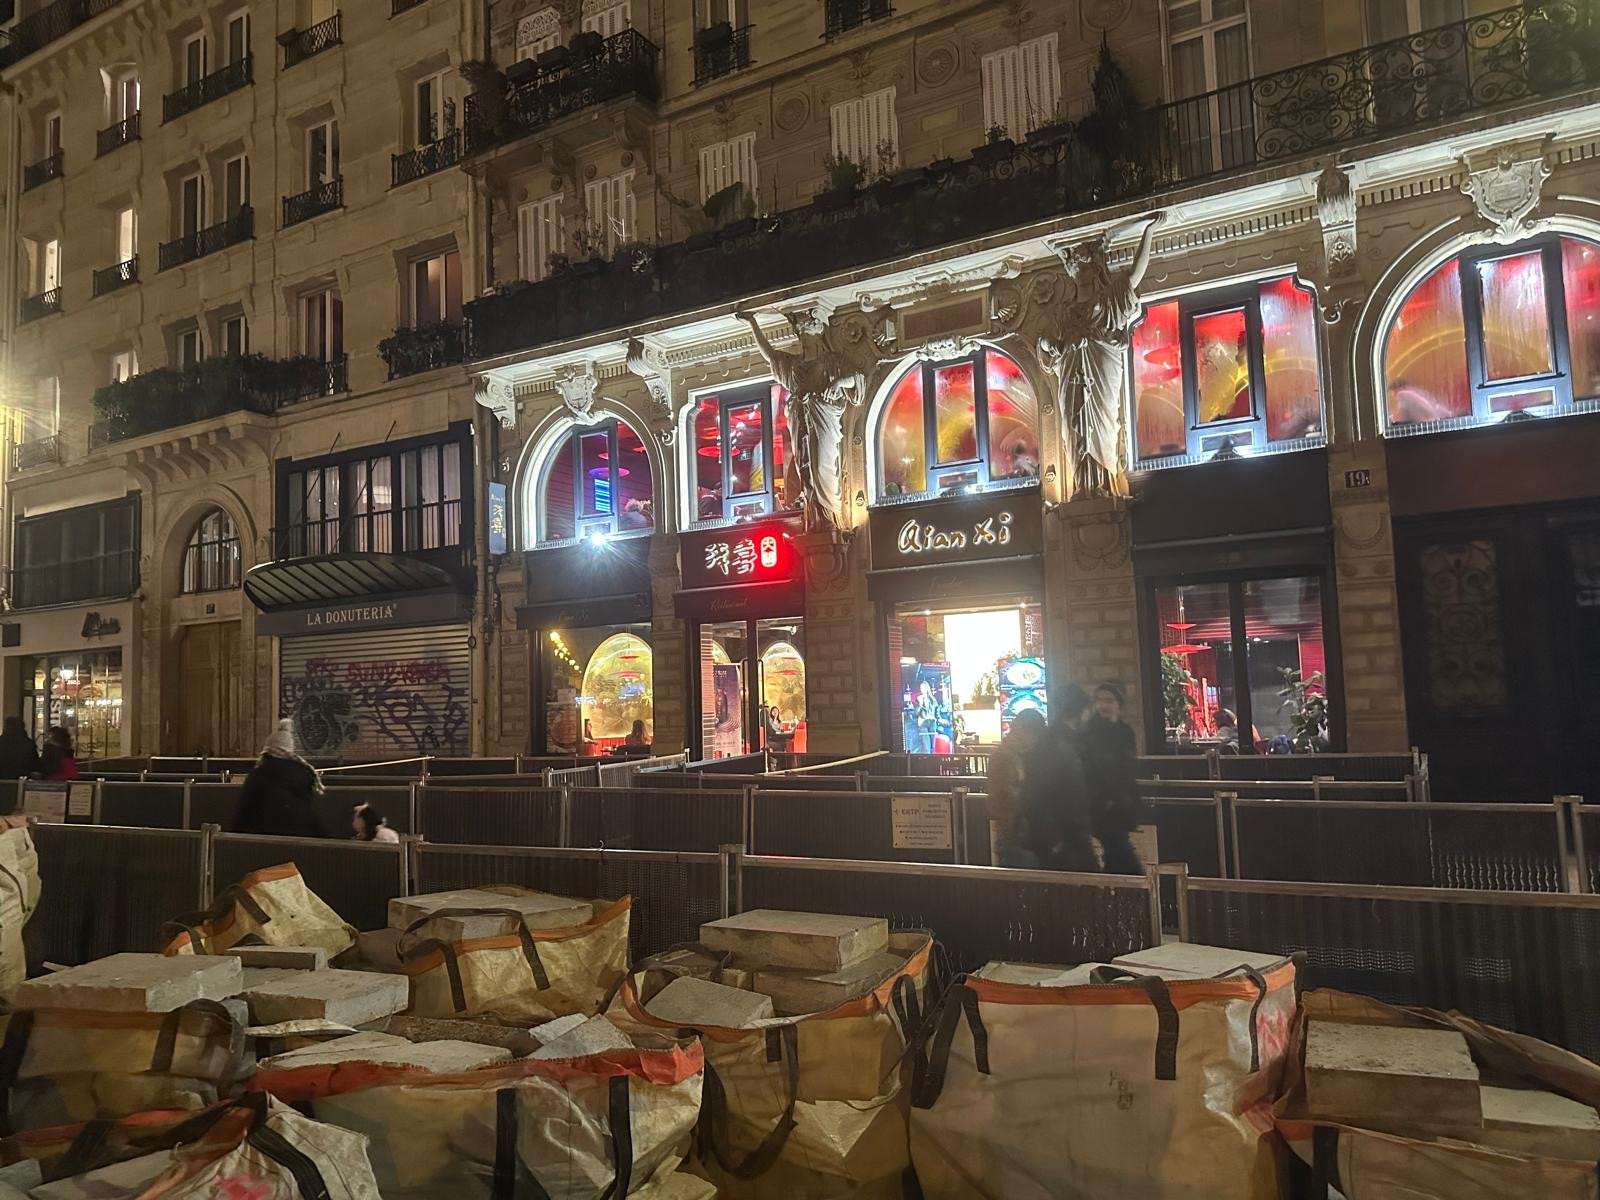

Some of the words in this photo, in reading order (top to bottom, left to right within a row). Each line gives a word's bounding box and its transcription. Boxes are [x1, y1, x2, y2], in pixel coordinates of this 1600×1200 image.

[1348, 471, 1366, 488] 19
[897, 518, 967, 554] Qian
[972, 511, 1012, 545] Xi
[307, 613, 322, 626] LA
[325, 606, 394, 624] DONUTERIA
